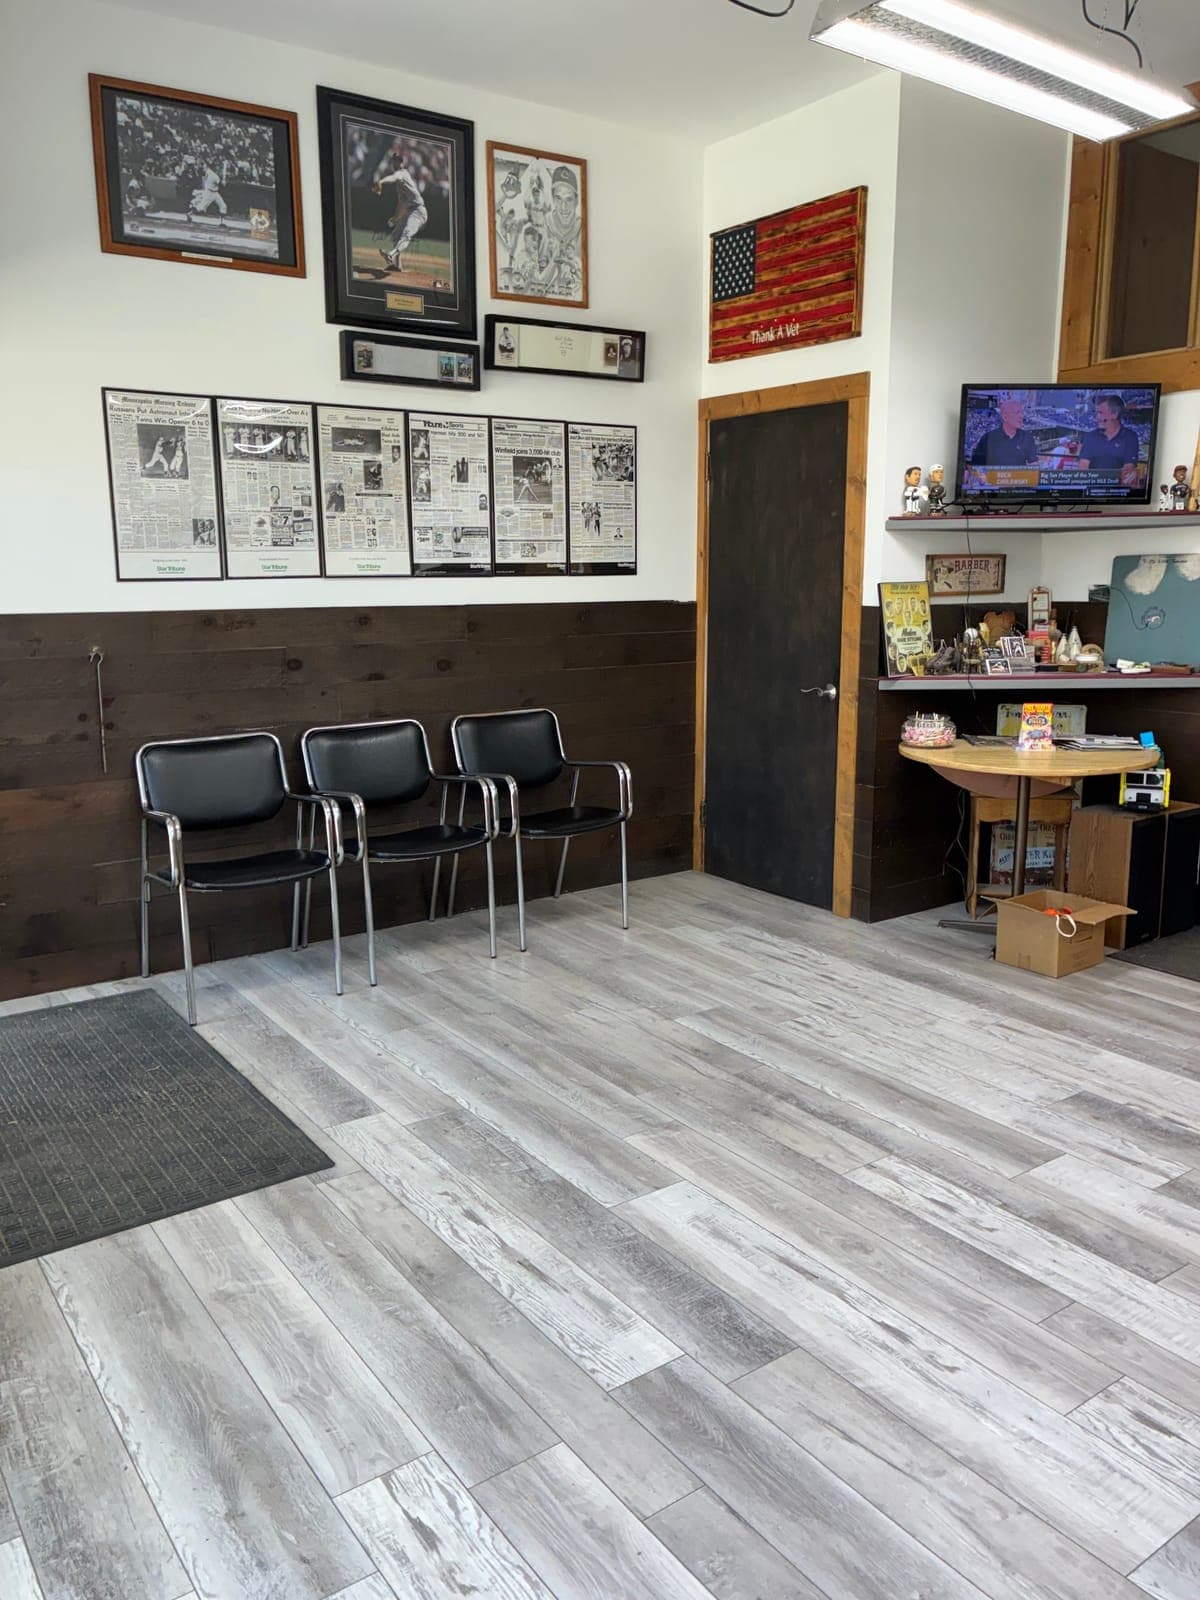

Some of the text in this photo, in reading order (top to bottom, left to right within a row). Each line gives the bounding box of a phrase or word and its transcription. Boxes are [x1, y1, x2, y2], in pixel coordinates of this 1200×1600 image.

[750, 322, 800, 344] Thank A Vet
[109, 404, 136, 413] Russians
[136, 416, 153, 424] Twins
[954, 560, 990, 574] BARBER
